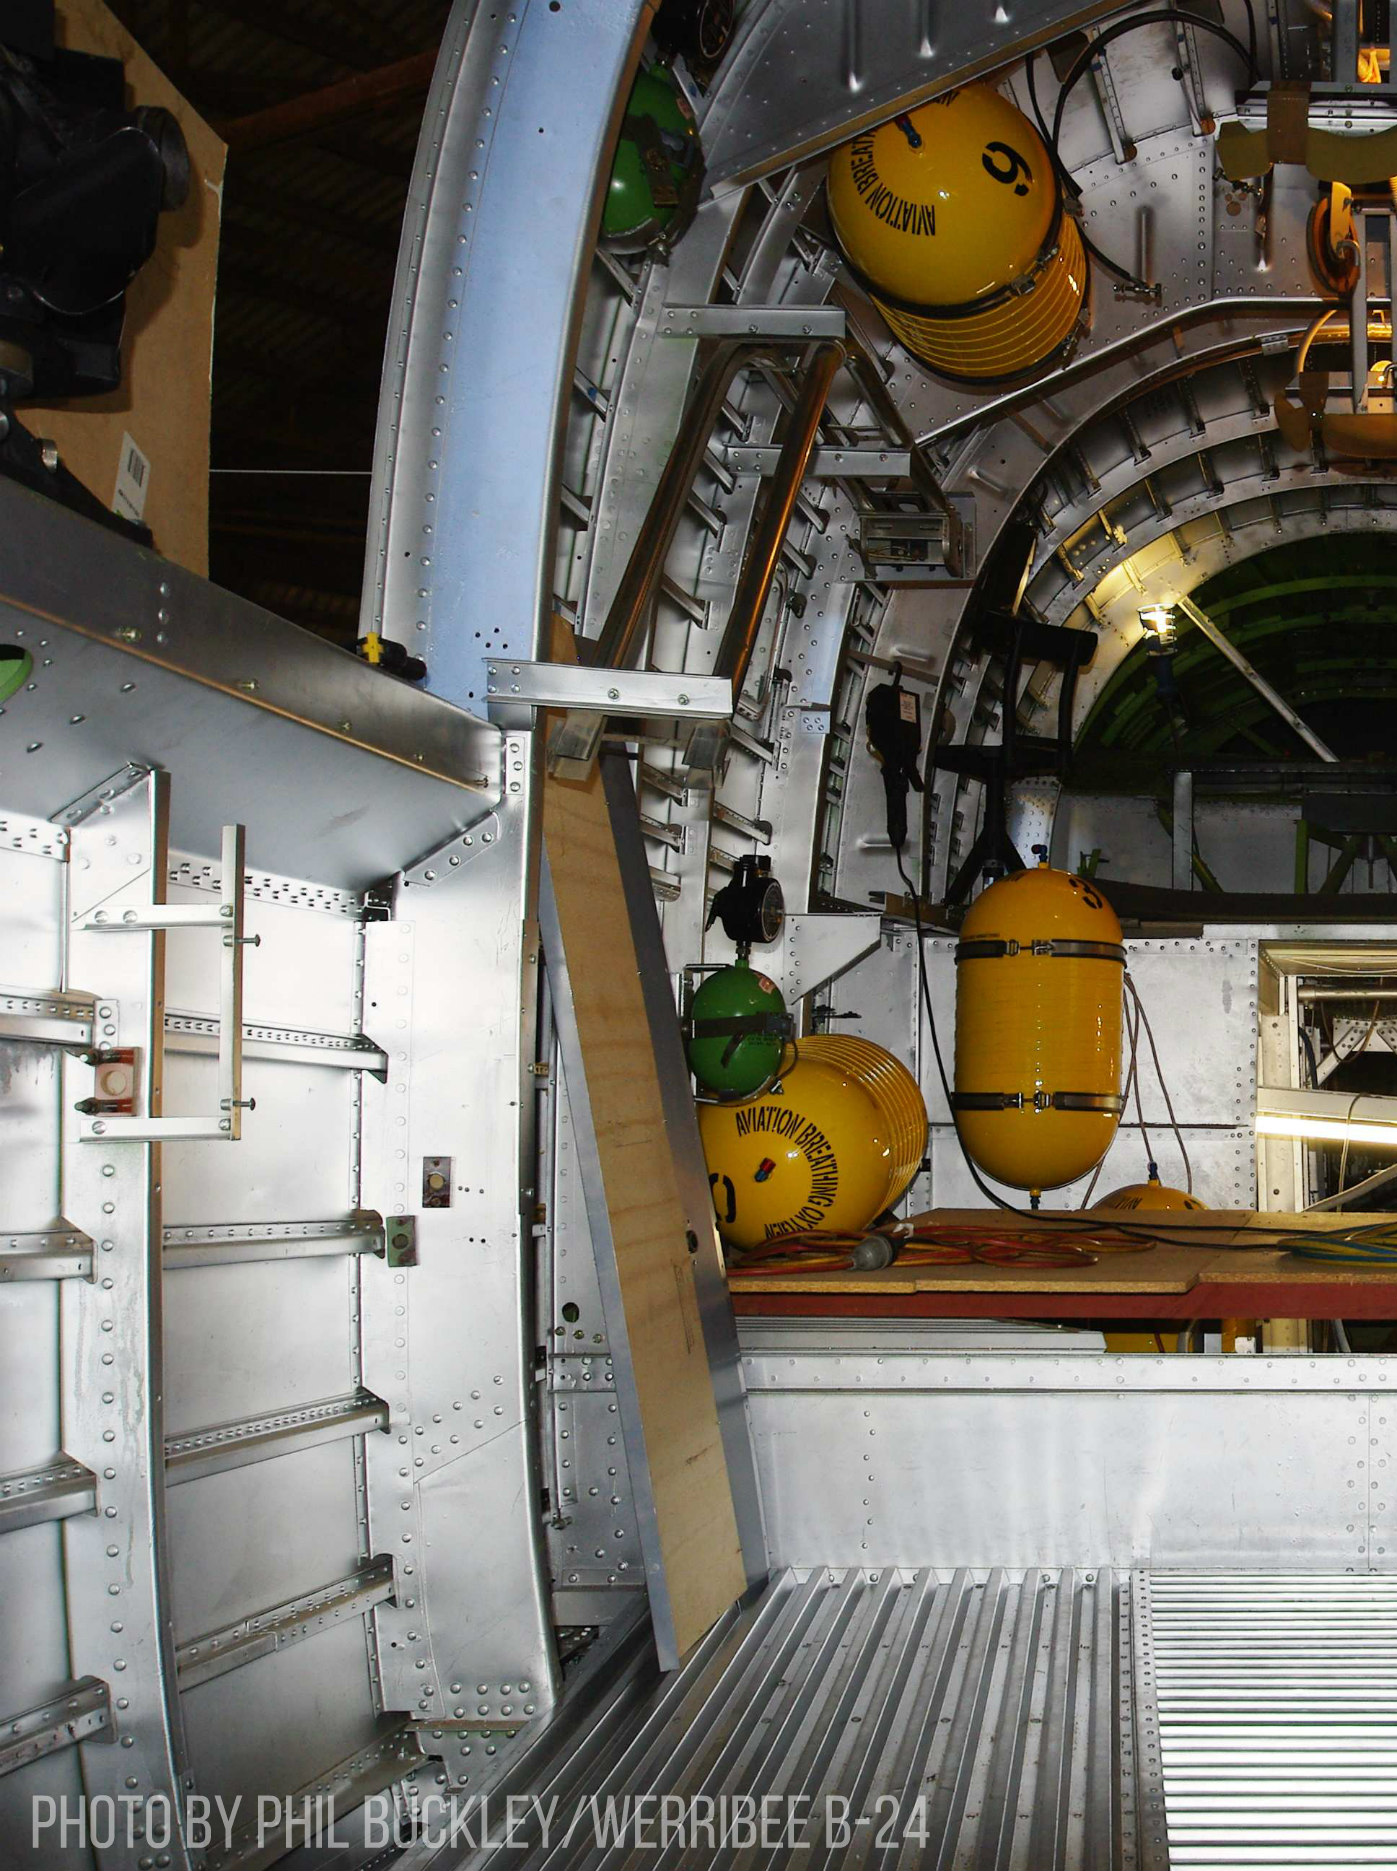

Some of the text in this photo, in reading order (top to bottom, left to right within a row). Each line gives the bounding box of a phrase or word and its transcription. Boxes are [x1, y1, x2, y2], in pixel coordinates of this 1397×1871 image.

[850, 131, 936, 237] AVIATION BREAT
[1068, 877, 1104, 910] 3
[735, 1106, 806, 1139] AVIATION
[797, 1123, 839, 1208] BREATHING
